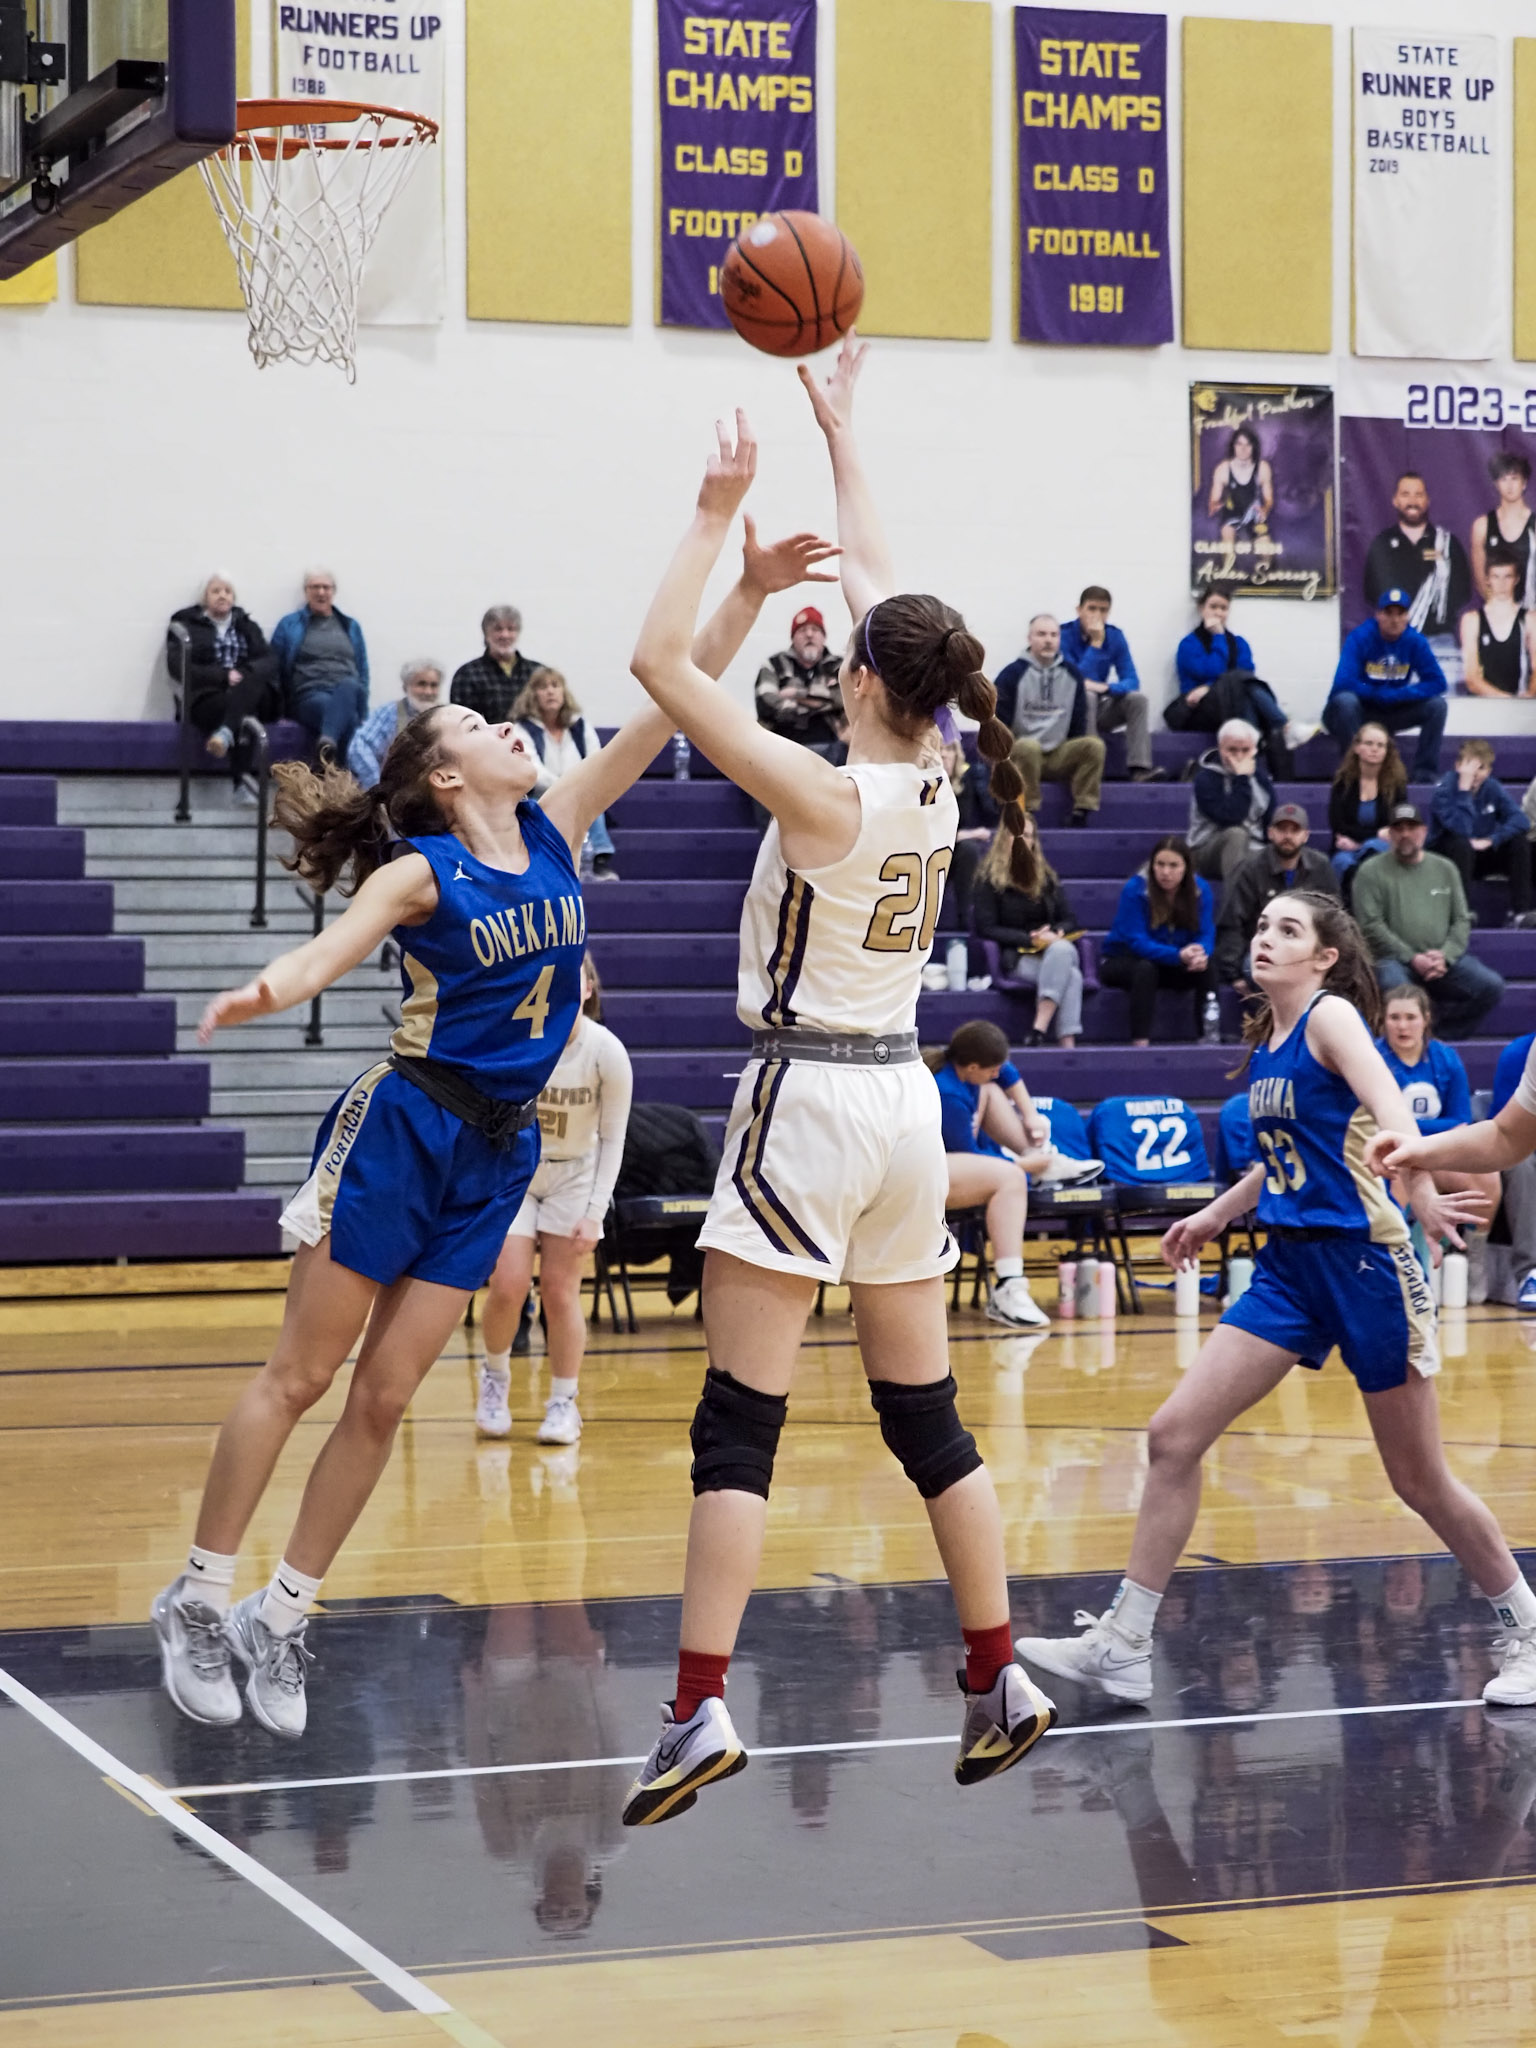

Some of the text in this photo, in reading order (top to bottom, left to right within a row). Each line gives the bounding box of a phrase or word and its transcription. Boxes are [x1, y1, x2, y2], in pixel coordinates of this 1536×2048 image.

[281, 6, 441, 40] RUNNERS UP
[684, 17, 792, 59] STATE
[304, 45, 420, 73] FOOTBALL
[1040, 39, 1141, 80] STATE
[1398, 45, 1459, 66] STATE
[667, 69, 812, 113] CHAMPS
[1362, 72, 1495, 101] RUNNER UP
[1023, 91, 1161, 132] CHAMPS
[1402, 109, 1455, 129] BOYS
[1367, 129, 1490, 155] BASKETBALL
[675, 144, 803, 178] CLASS D
[1033, 164, 1155, 194] CLASS D
[1027, 227, 1160, 258] FOOTBALL
[1069, 284, 1124, 314] 1991
[862, 845, 953, 953] 20
[511, 964, 555, 1039] 4
[1131, 1116, 1191, 1171] 22
[1258, 1129, 1307, 1195] 33
